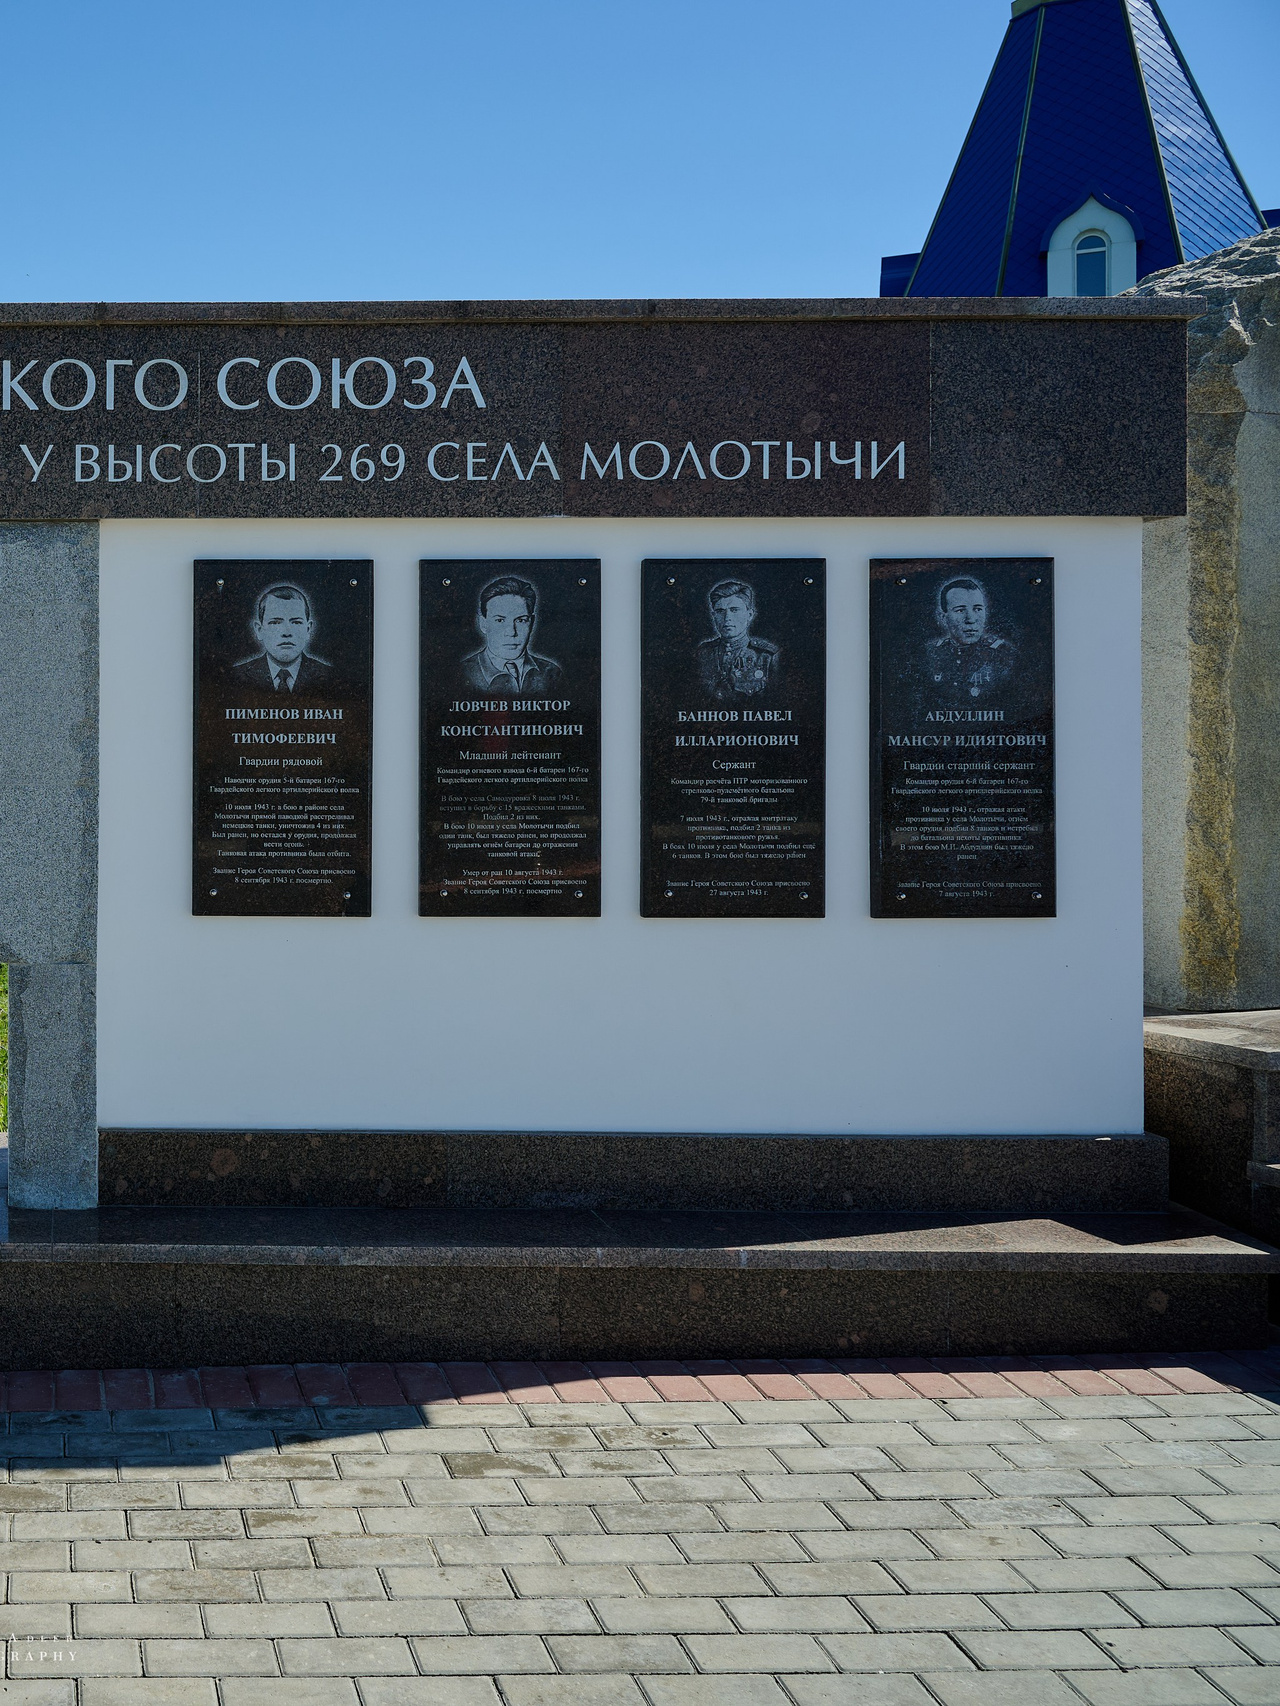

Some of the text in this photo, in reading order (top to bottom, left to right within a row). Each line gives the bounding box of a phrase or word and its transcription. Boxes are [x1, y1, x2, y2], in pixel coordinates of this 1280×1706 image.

[217, 356, 487, 410] СОЮЗА
[19, 444, 54, 482] У
[75, 443, 296, 483] ВЫСОТЫ
[318, 443, 406, 482] 269
[427, 441, 561, 481] СЕЛА
[580, 440, 905, 480] МОЛОТЫЧИ
[449, 700, 571, 711] ЛОВЧЕВ ВИКТОР
[225, 708, 343, 719] ПИМЕНОВ ИВАН
[678, 711, 792, 721] БАННОВ ПАВЕЛ
[925, 711, 1005, 723] АБДУЛЛИН
[441, 725, 584, 736] КОНСТАНТИНОВИЧ
[231, 733, 336, 744] ТИМОФЕЕВИЧ
[675, 735, 799, 746] ИЛЛАРИОНОВИЧ
[888, 735, 1046, 748] МАНСУР ИДИЯТОВИЧ
[459, 751, 562, 761] Младший лейтенант
[239, 757, 323, 768] Гвардии рядовой
[712, 759, 756, 771] Сержант
[904, 761, 1036, 772] Гвардии старший сержант
